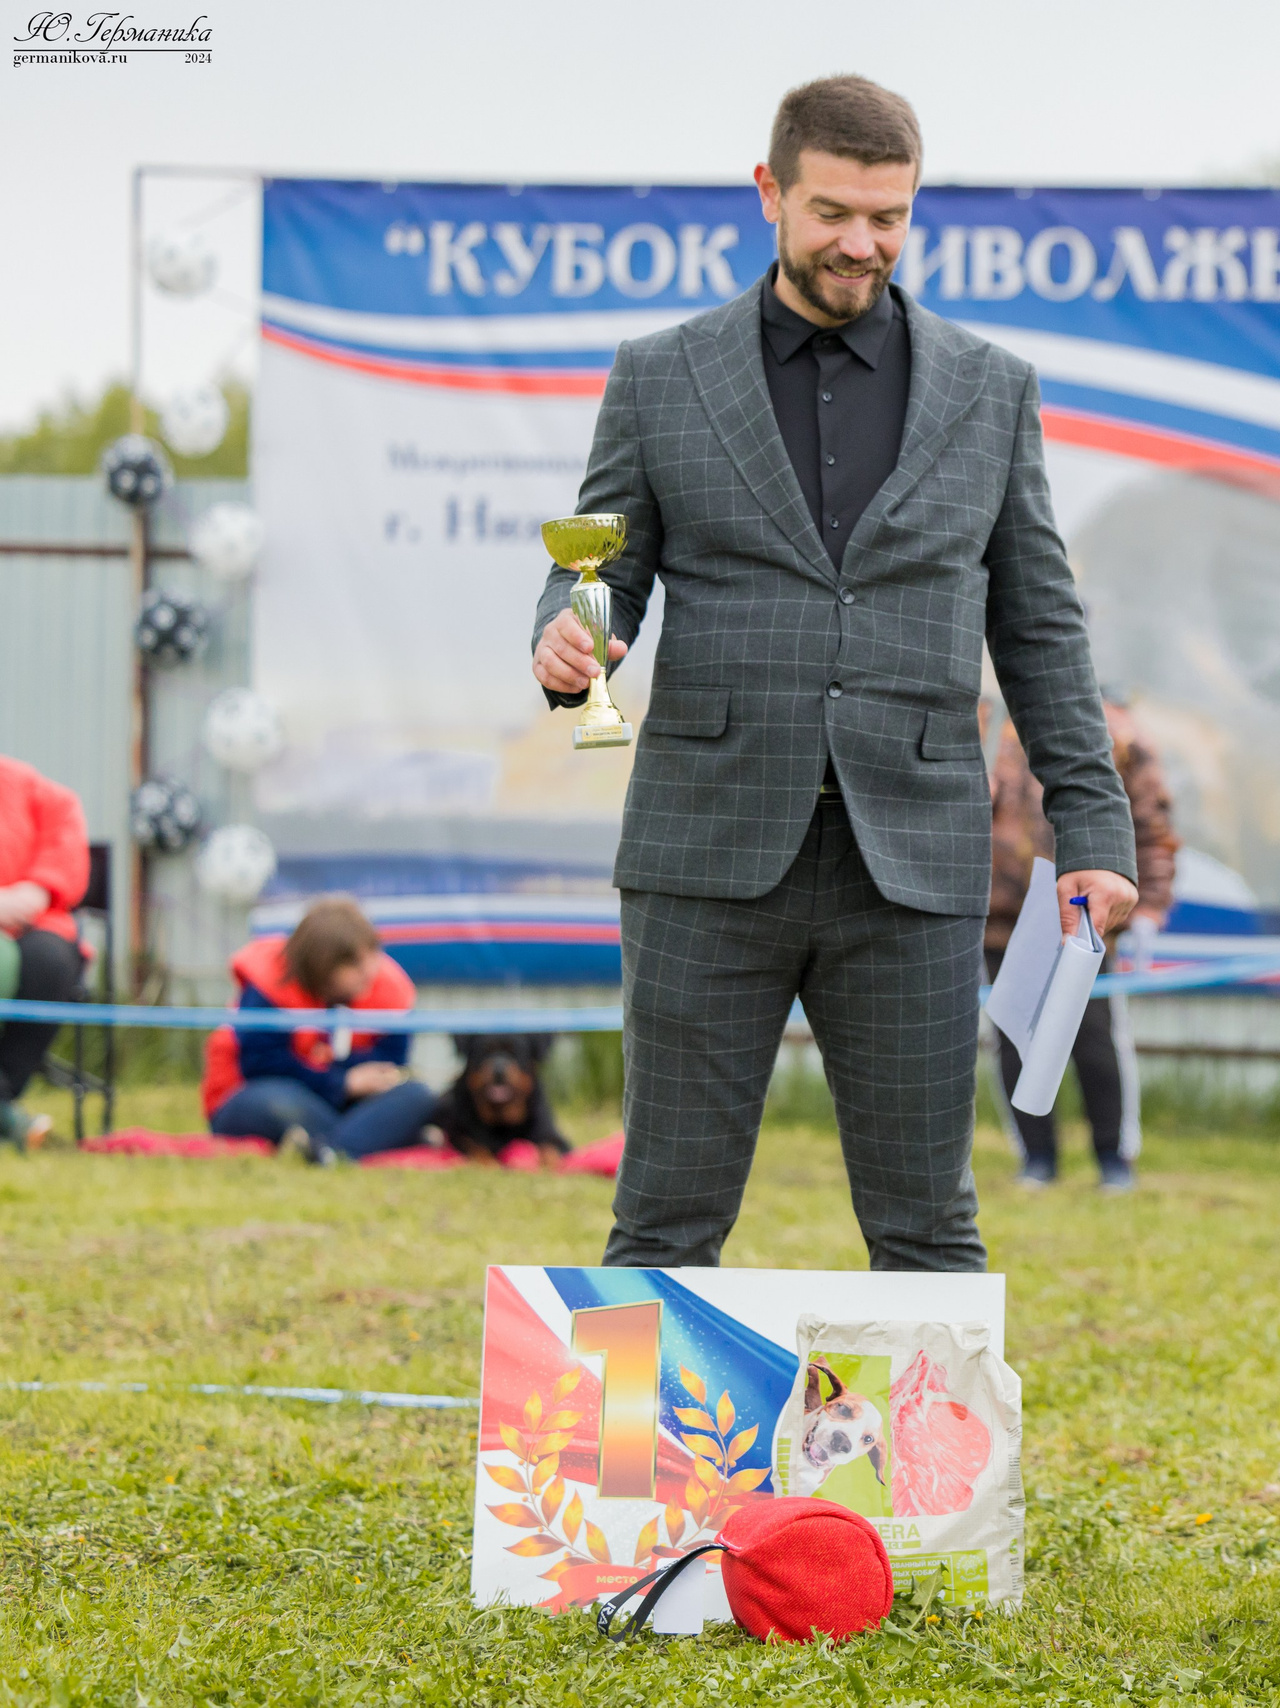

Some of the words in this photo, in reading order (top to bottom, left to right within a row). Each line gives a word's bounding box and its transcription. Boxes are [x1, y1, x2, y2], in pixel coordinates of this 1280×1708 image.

[571, 1299, 664, 1499] 1
[875, 1523, 920, 1539] ERA
[891, 1561, 926, 1569] ОВАННЫЙ
